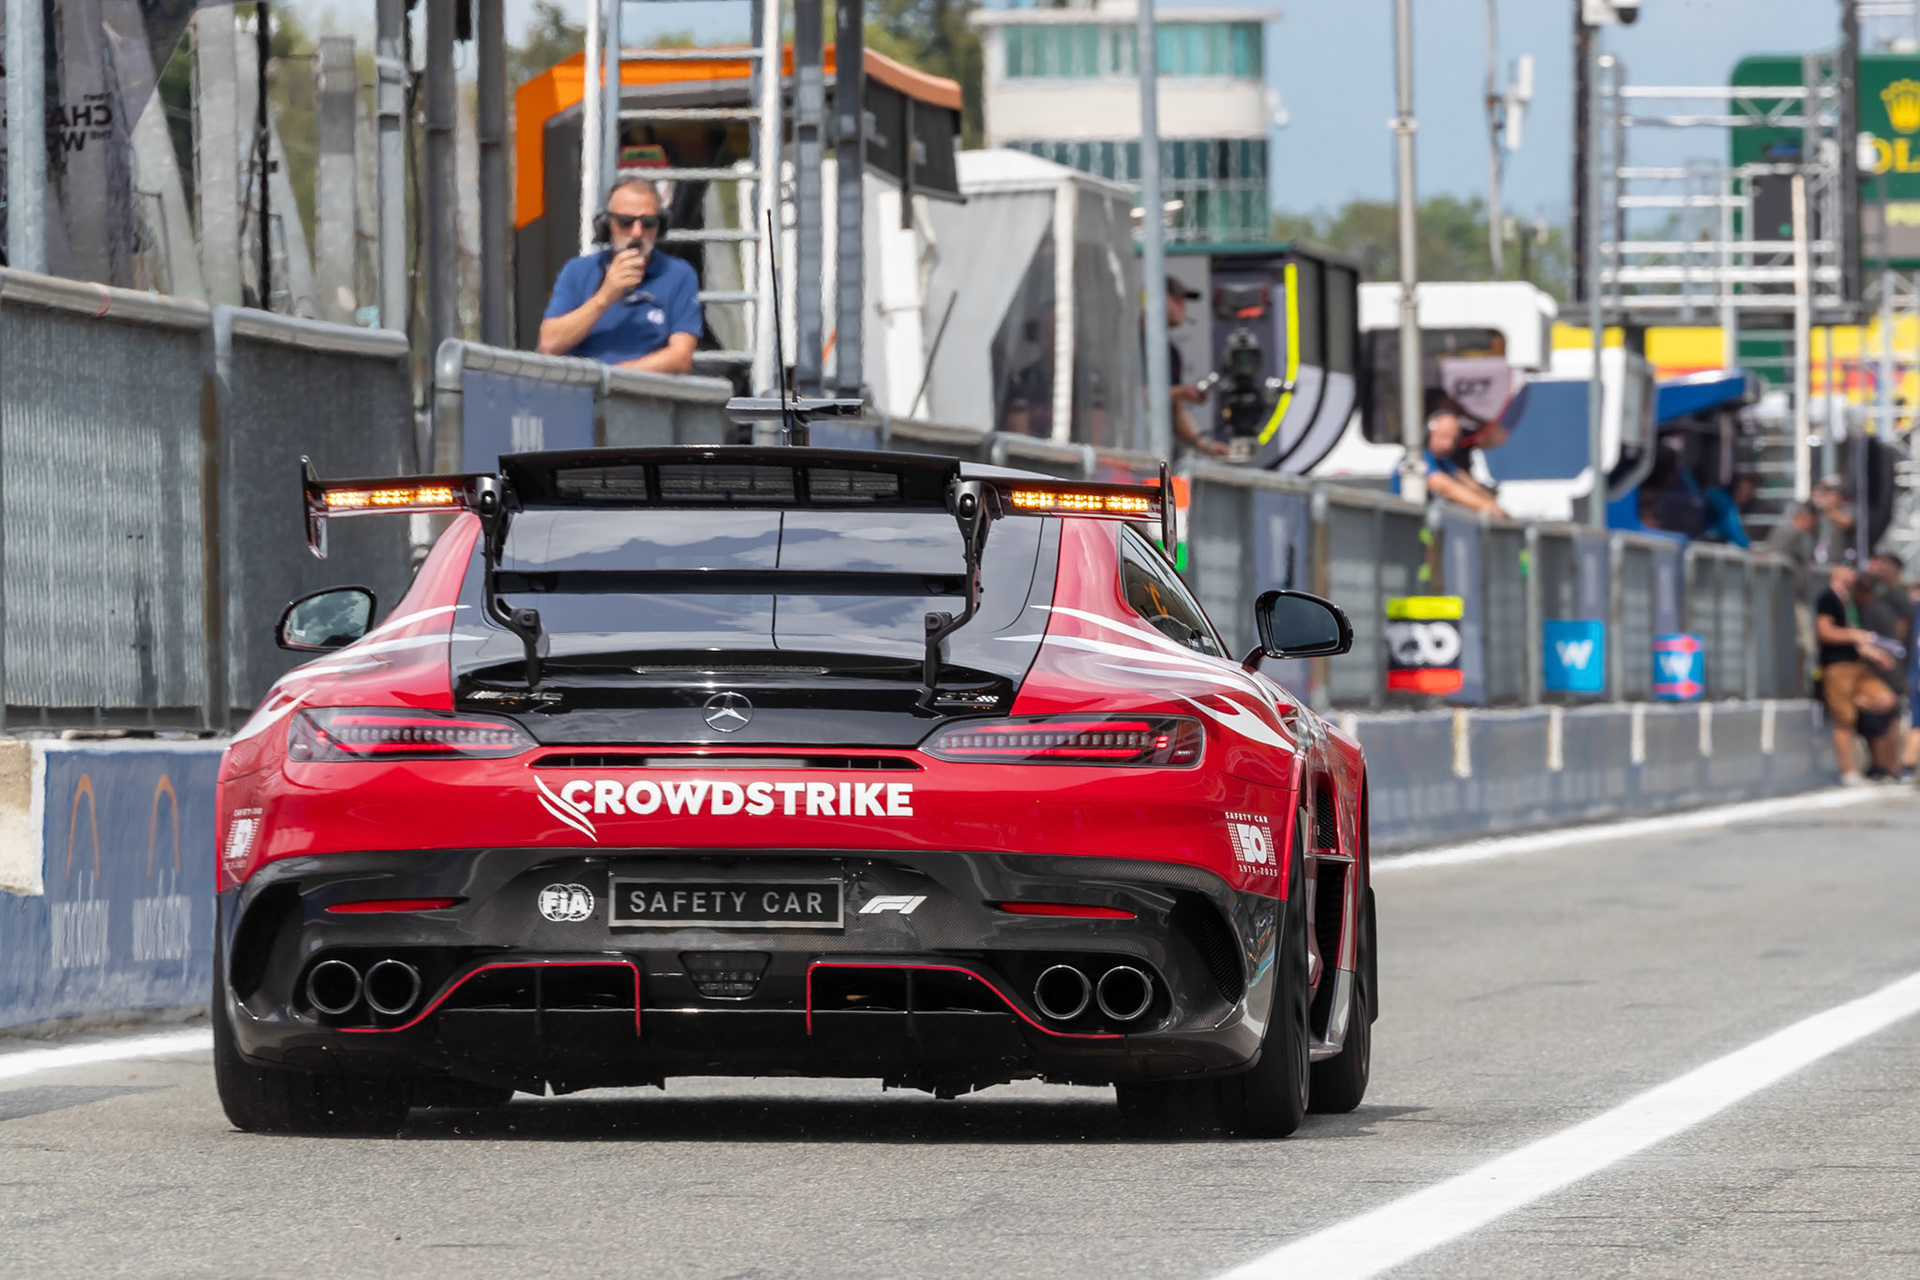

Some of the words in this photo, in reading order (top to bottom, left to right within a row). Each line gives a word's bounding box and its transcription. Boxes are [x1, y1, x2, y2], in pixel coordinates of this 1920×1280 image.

[560, 779, 914, 817] CROWDSTRIKE
[1225, 811, 1252, 822] SAFETY
[1254, 814, 1269, 824] CAR
[1236, 823, 1268, 865] 50
[629, 890, 748, 914] SAFETY
[761, 891, 824, 915] CAR
